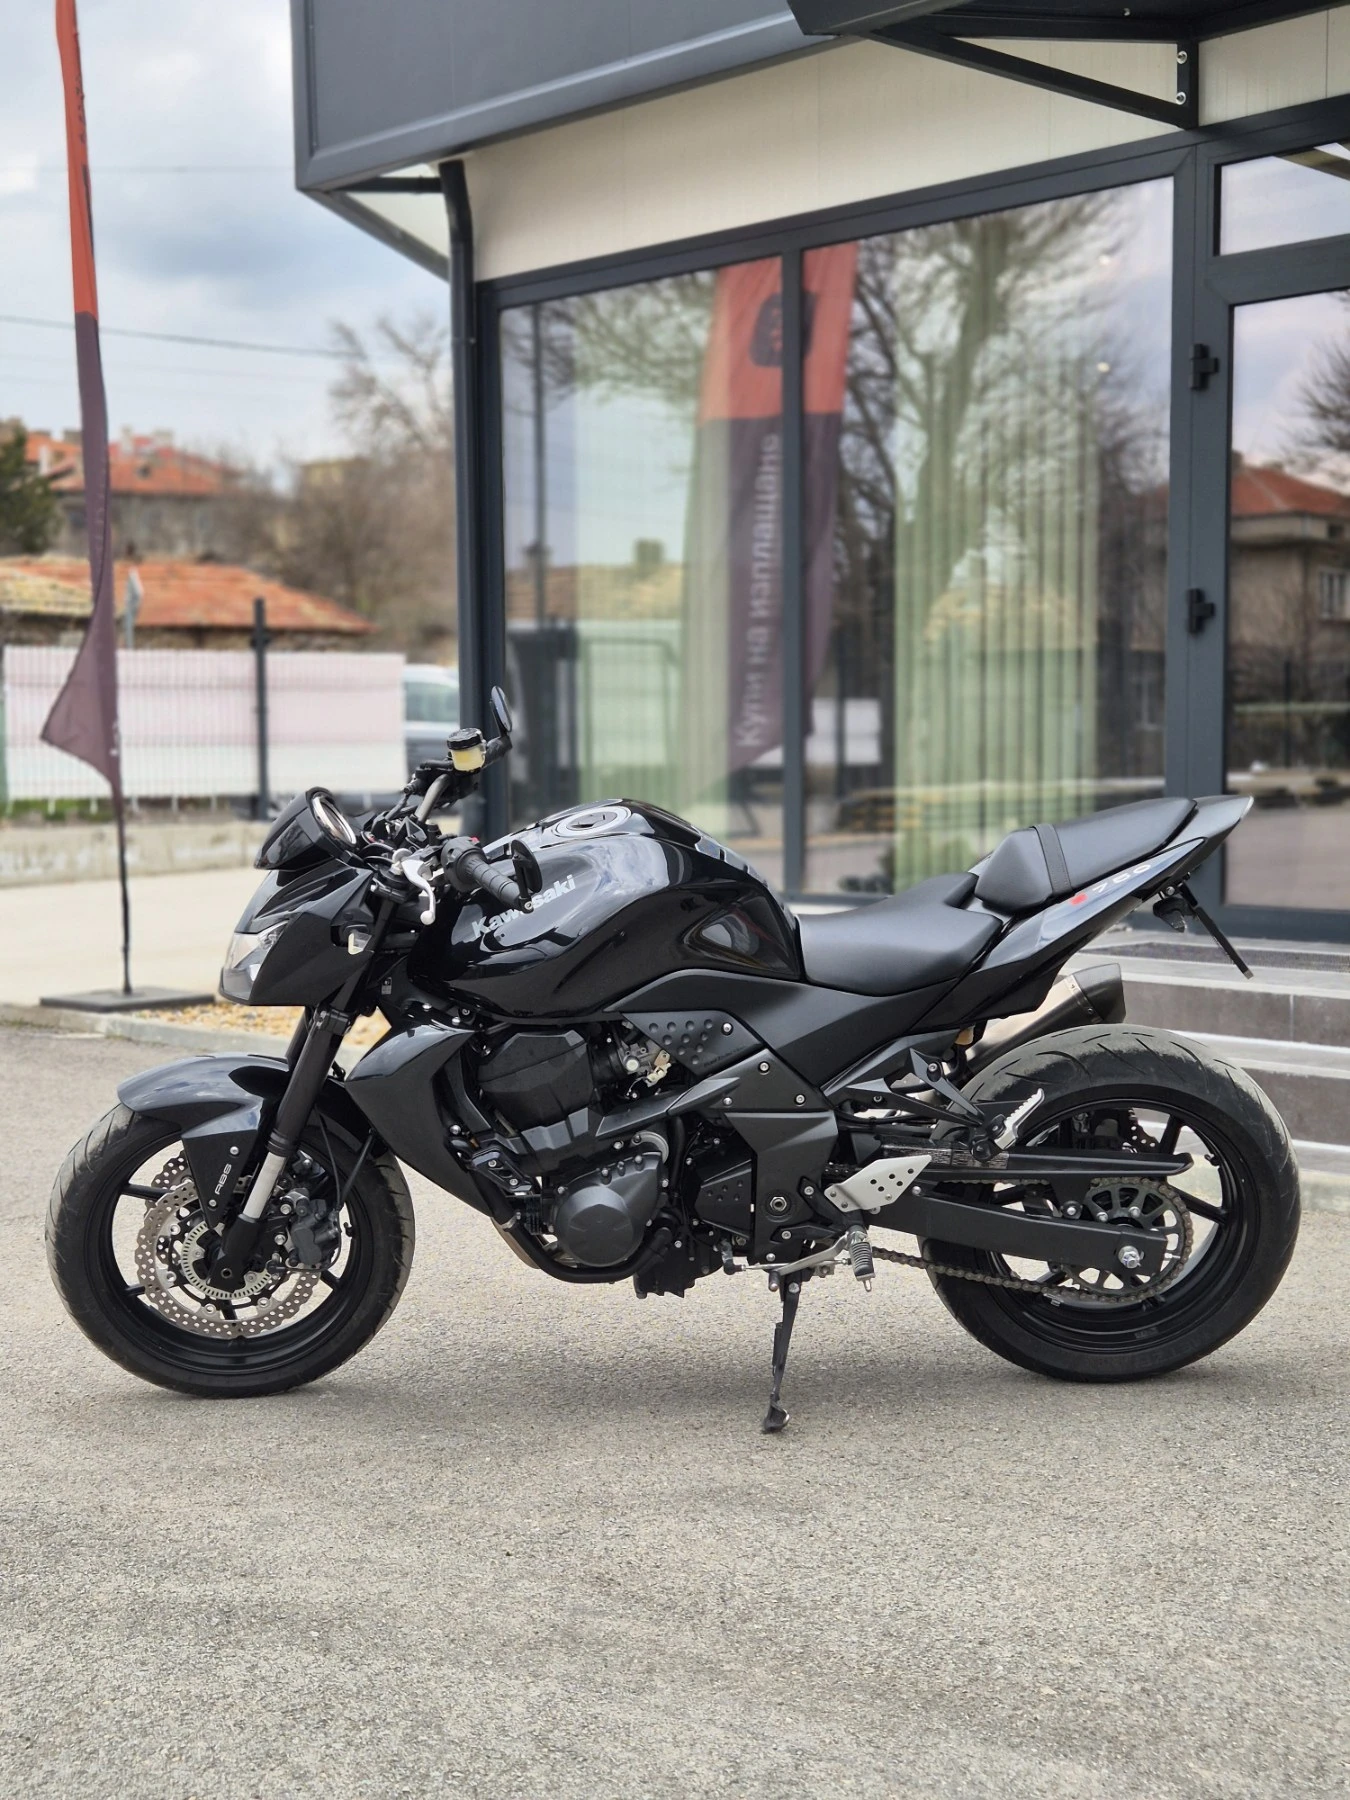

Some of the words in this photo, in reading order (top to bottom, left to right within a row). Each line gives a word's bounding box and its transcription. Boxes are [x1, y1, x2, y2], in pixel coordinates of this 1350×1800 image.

[750, 434, 780, 617] изплащане
[746, 627, 770, 664] на
[734, 672, 769, 748] Купи
[471, 874, 576, 939] Kawsaki
[214, 1163, 232, 1195] ABS
